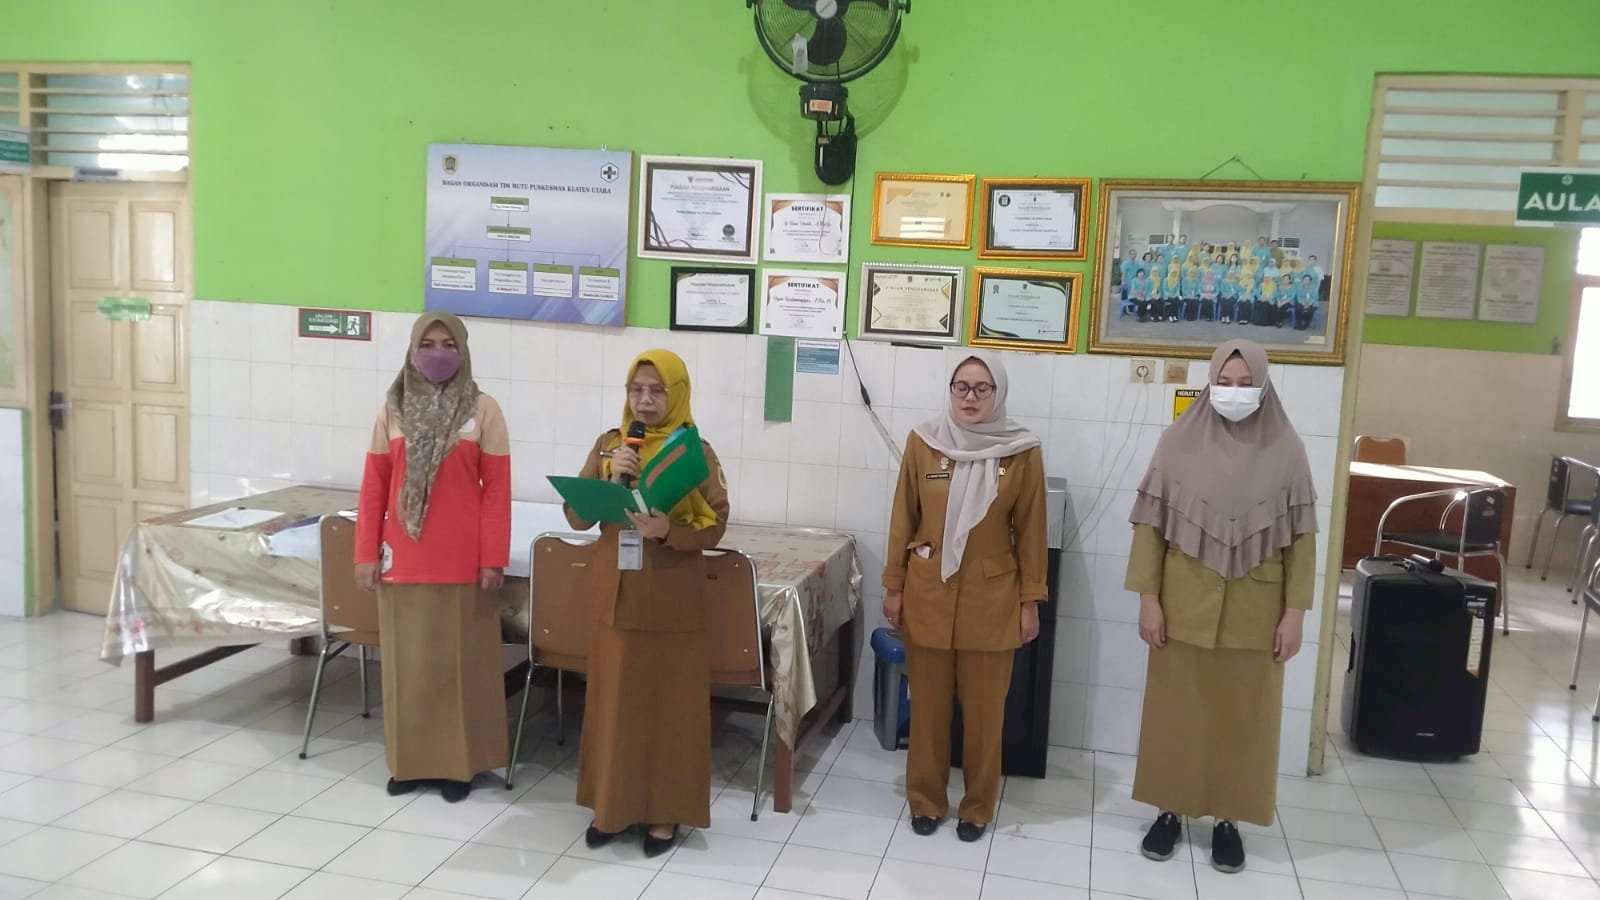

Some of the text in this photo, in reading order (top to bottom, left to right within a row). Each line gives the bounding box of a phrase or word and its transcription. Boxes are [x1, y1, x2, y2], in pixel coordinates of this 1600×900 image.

[442, 179, 462, 187] BAGAN
[463, 181, 499, 189] ORGANISASI
[530, 184, 566, 192] PUSKESMAS
[567, 185, 590, 193] KLATEN
[591, 186, 612, 194] UTARA
[1523, 191, 1600, 212] AULA
[787, 281, 820, 289] SERTIFIKAT
